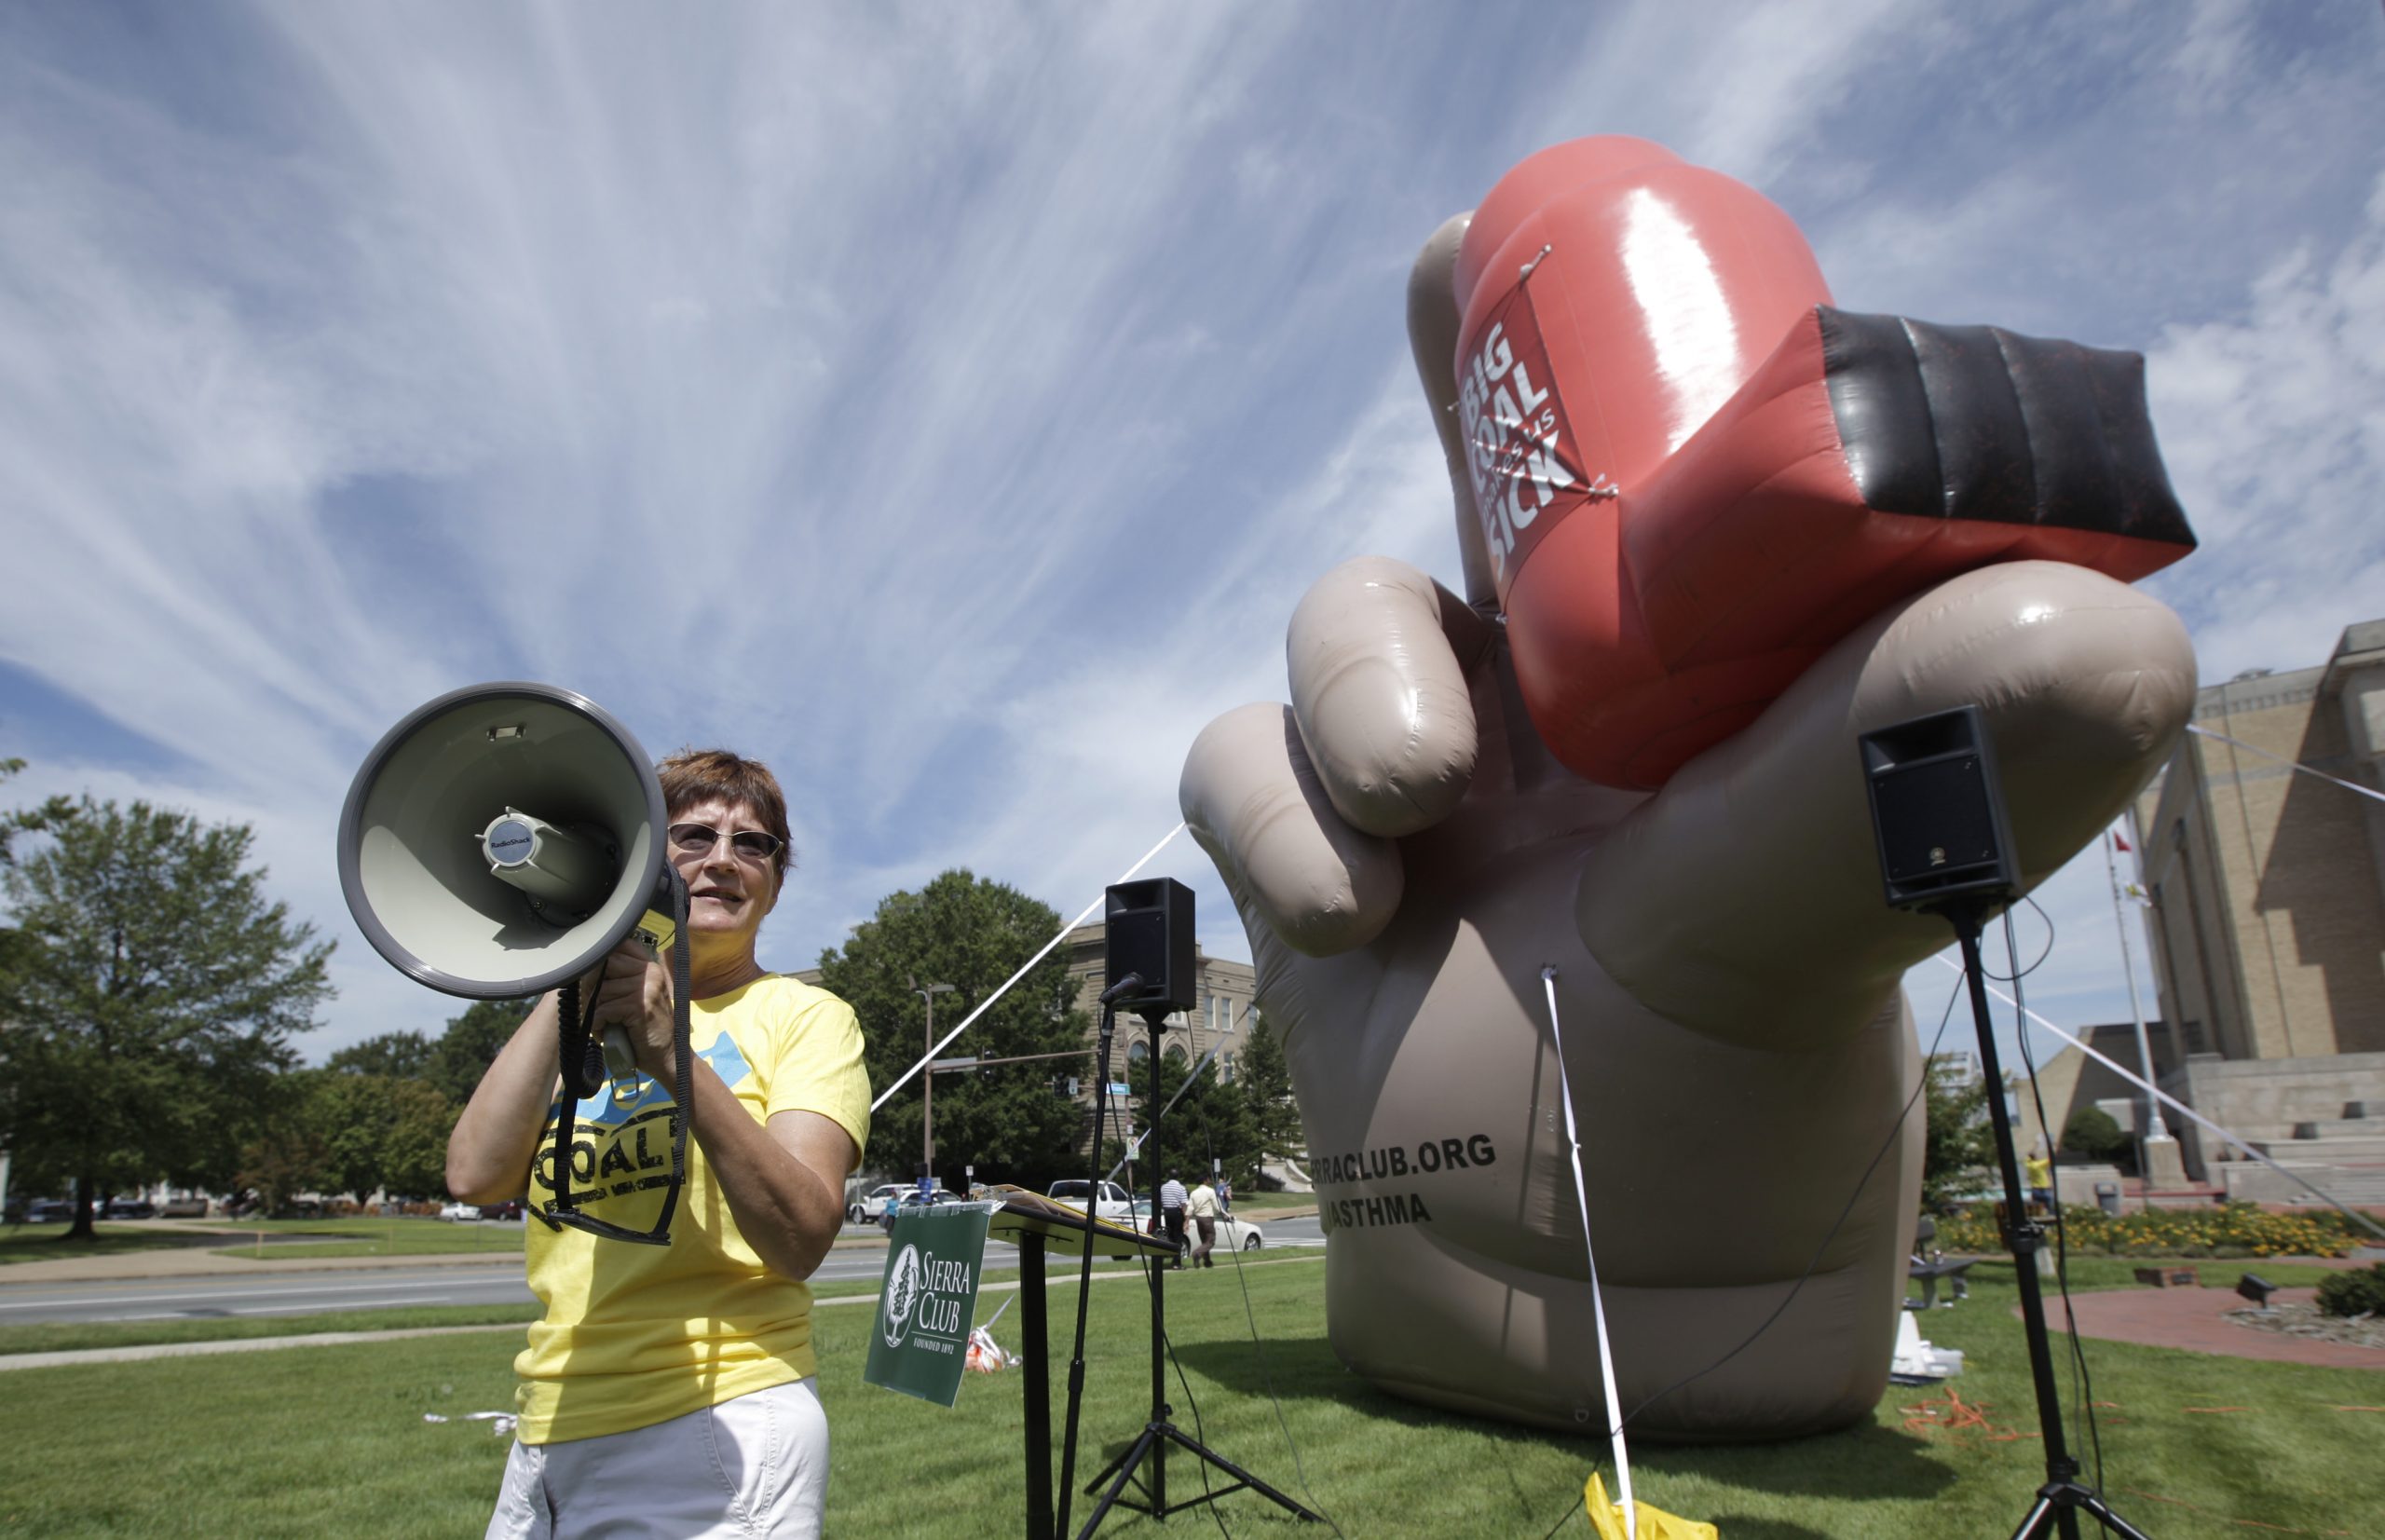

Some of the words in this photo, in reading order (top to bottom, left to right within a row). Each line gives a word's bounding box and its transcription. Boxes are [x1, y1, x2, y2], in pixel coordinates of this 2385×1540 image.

[1462, 321, 1513, 427] BIG
[1471, 361, 1548, 495] COAL
[1490, 429, 1575, 582] SICK
[491, 838, 529, 848] RadioShack
[920, 1251, 970, 1294] SIERRA
[919, 1291, 961, 1333] CLUB
[913, 1337, 940, 1352] FOUNDED
[941, 1342, 954, 1355] 1892
